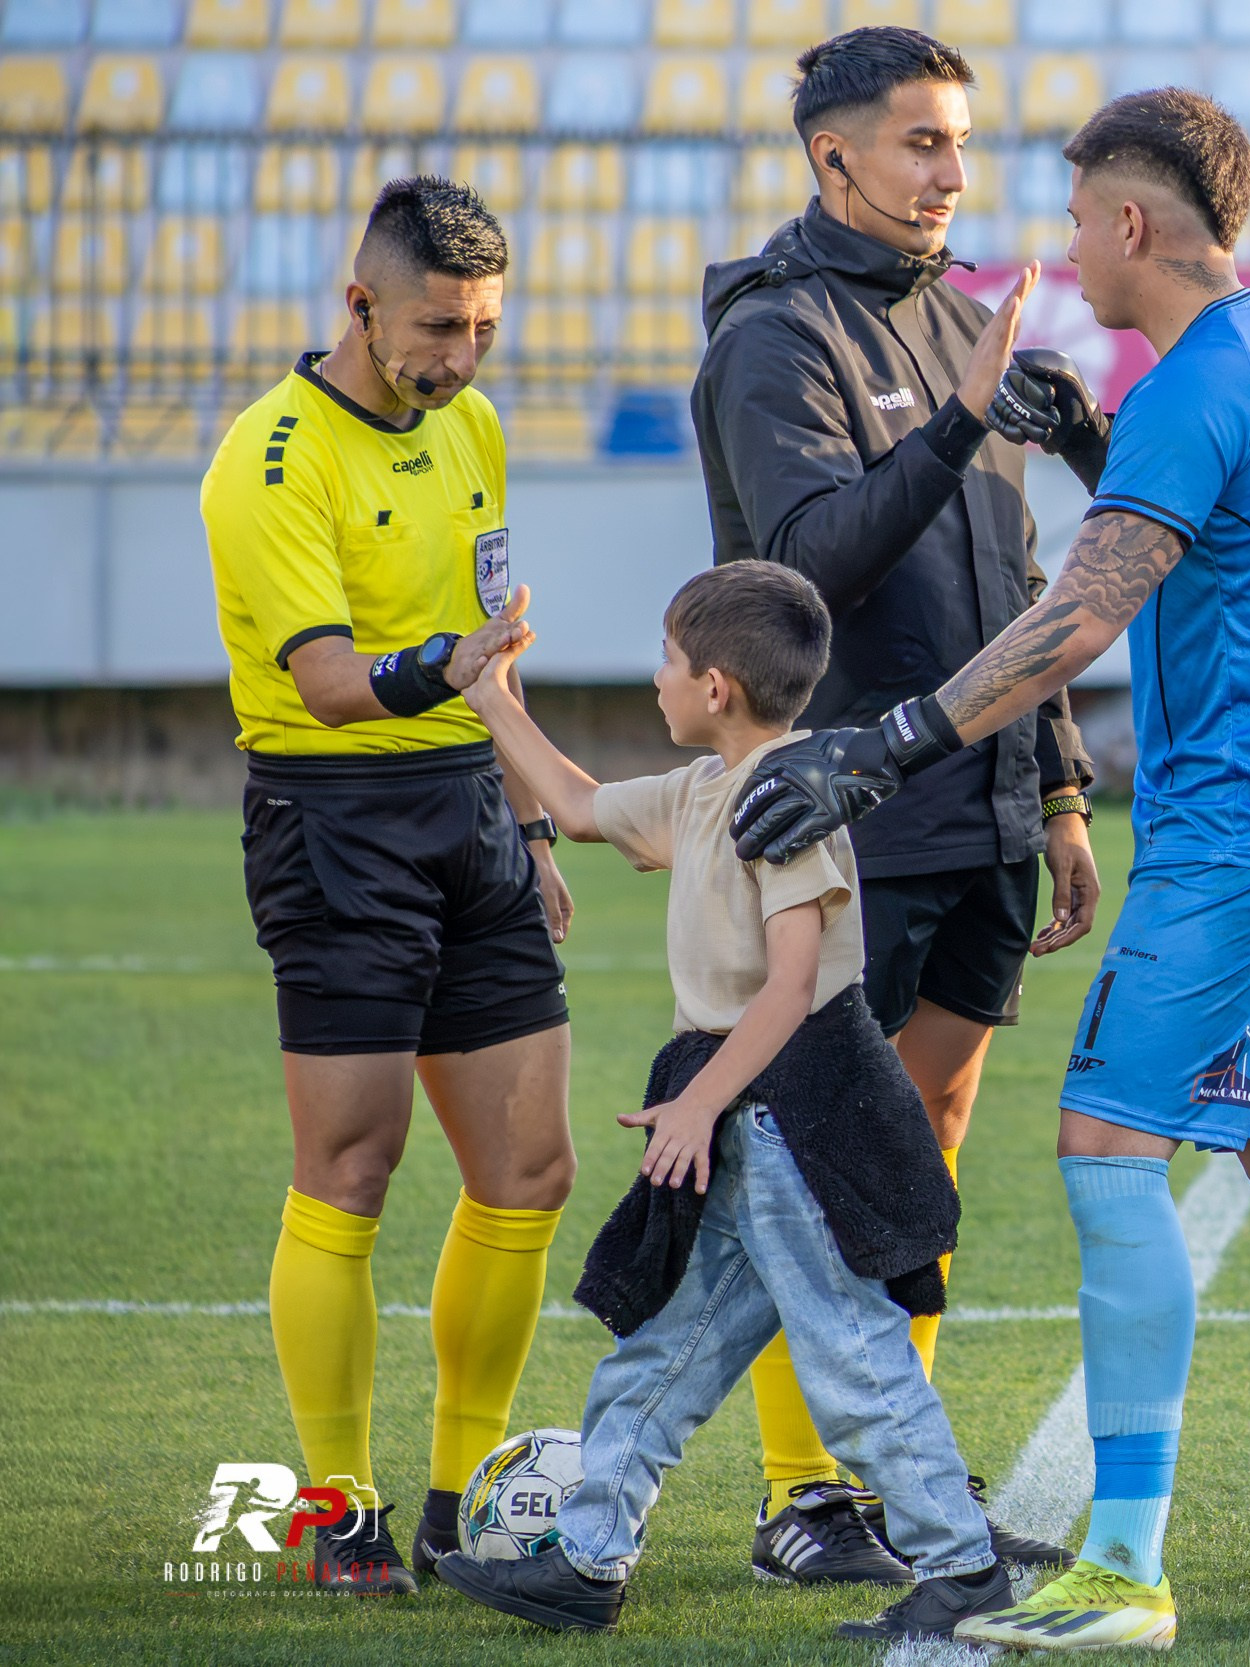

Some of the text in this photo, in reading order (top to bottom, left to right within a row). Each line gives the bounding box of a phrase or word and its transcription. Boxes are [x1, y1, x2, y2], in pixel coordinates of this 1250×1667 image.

[392, 450, 433, 475] capelli
[1119, 946, 1158, 962] Riviera
[1084, 970, 1118, 1051] 1
[510, 1491, 558, 1518] SEL
